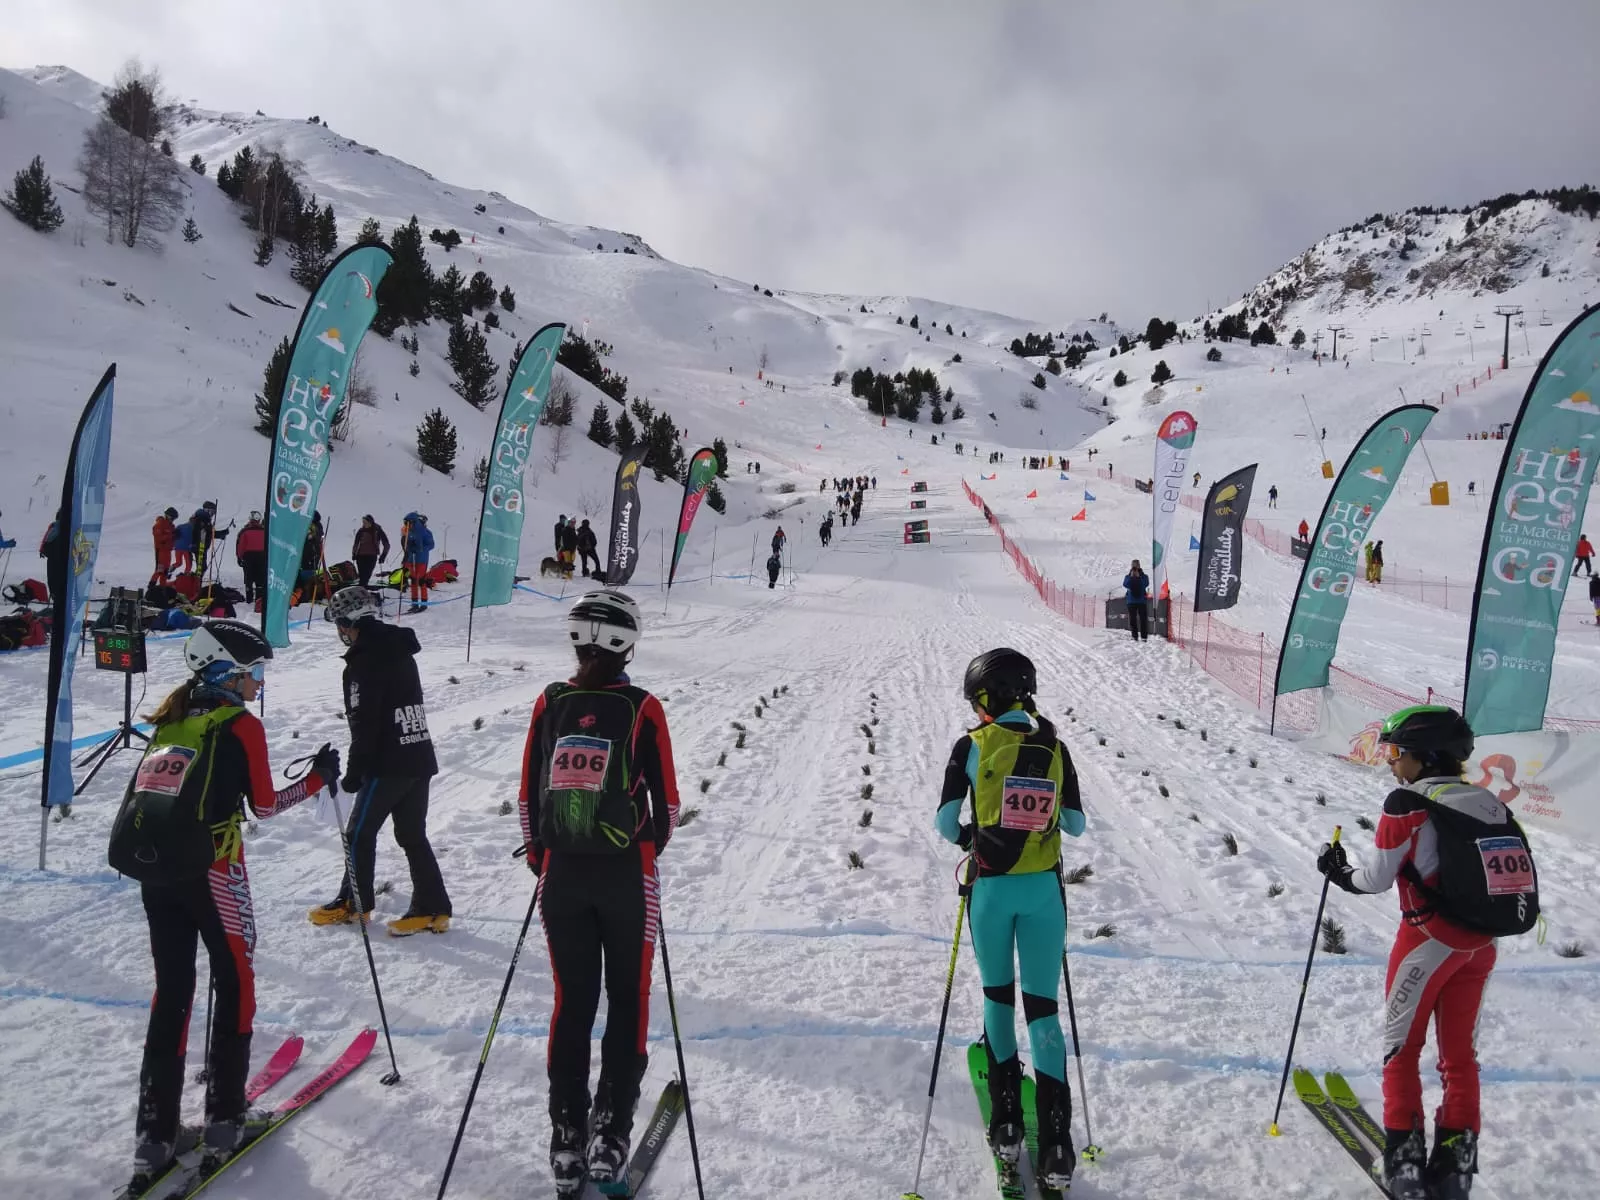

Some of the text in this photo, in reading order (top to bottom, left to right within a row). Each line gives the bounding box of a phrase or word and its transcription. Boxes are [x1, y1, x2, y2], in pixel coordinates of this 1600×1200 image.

[1160, 451, 1187, 513] cerler
[1492, 547, 1564, 591] ca
[141, 759, 185, 776] 409
[554, 752, 606, 773] 406
[1005, 793, 1052, 814] 407
[1486, 854, 1531, 875] 408
[646, 1107, 672, 1149] DYNAFIT
